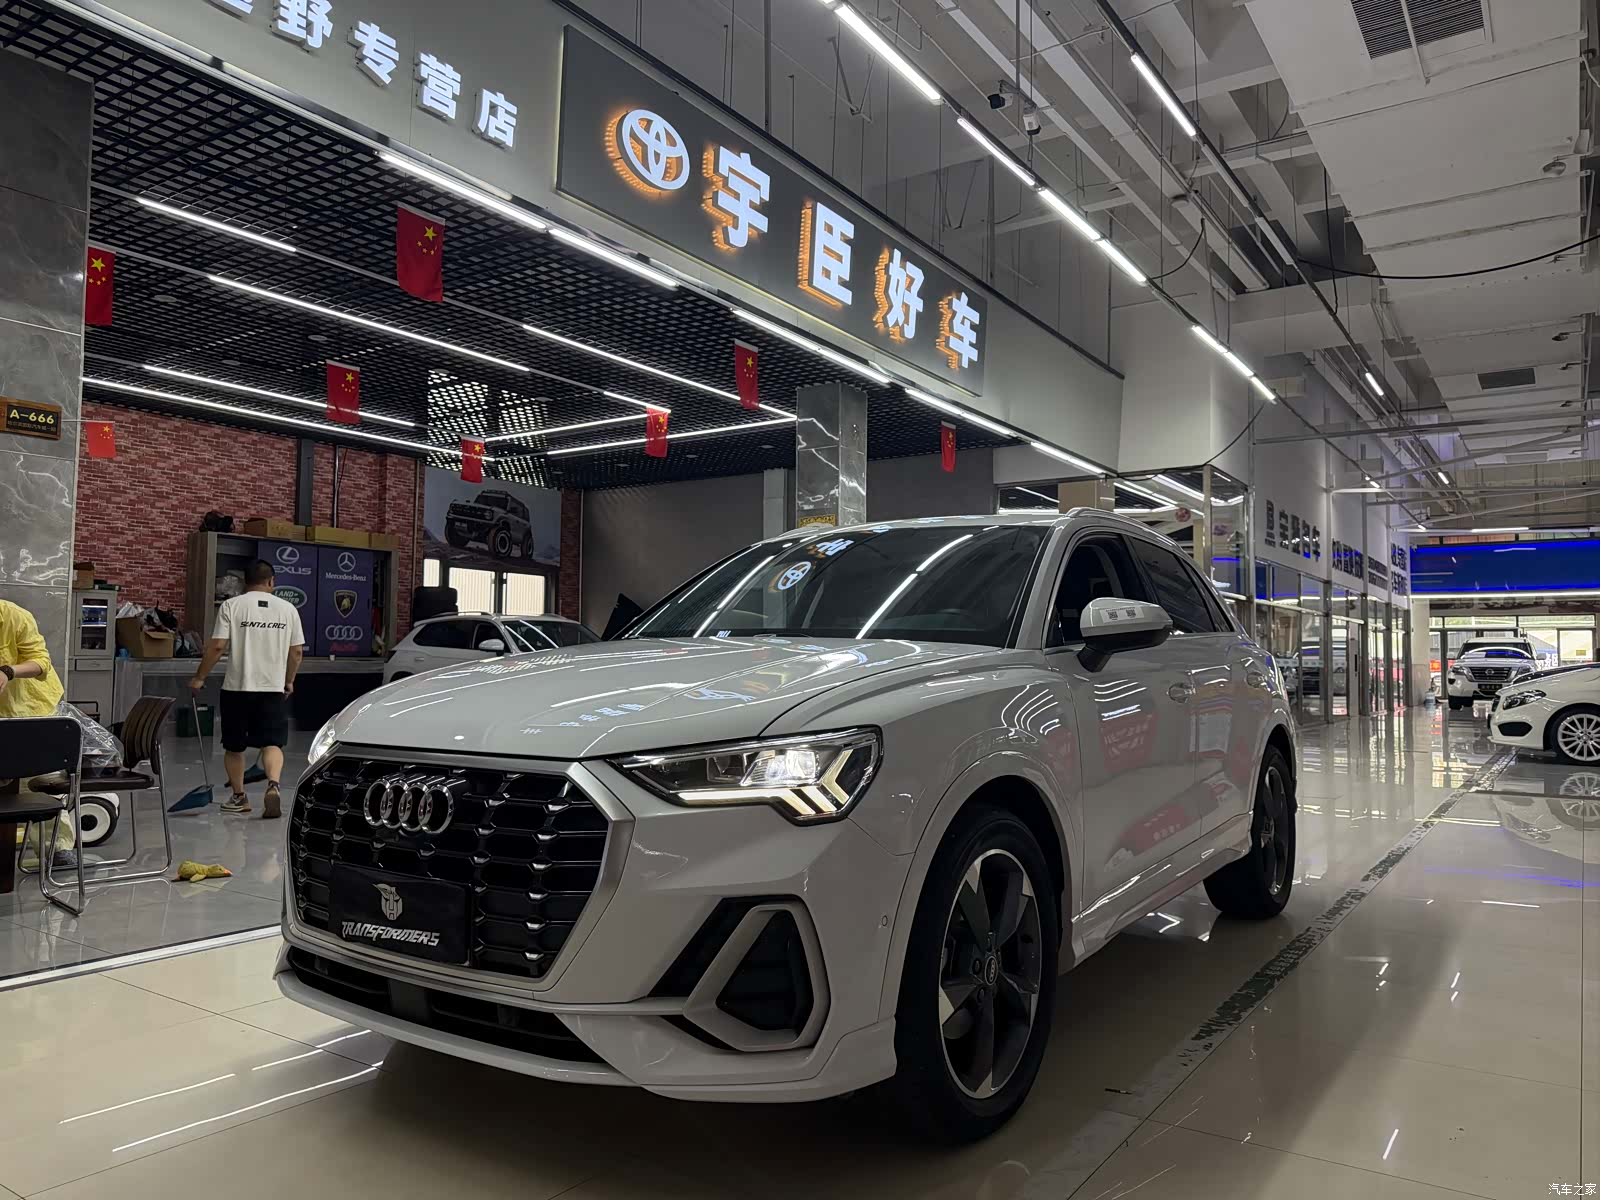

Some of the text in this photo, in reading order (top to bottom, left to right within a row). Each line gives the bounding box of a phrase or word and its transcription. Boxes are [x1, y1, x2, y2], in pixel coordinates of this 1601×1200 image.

[203, 0, 518, 148] 野专营店
[716, 145, 980, 369] 宇臣好车
[272, 565, 312, 575] EXUS
[325, 572, 367, 581] Mercedes-Benz
[341, 921, 440, 947] TRANSFORMERS
